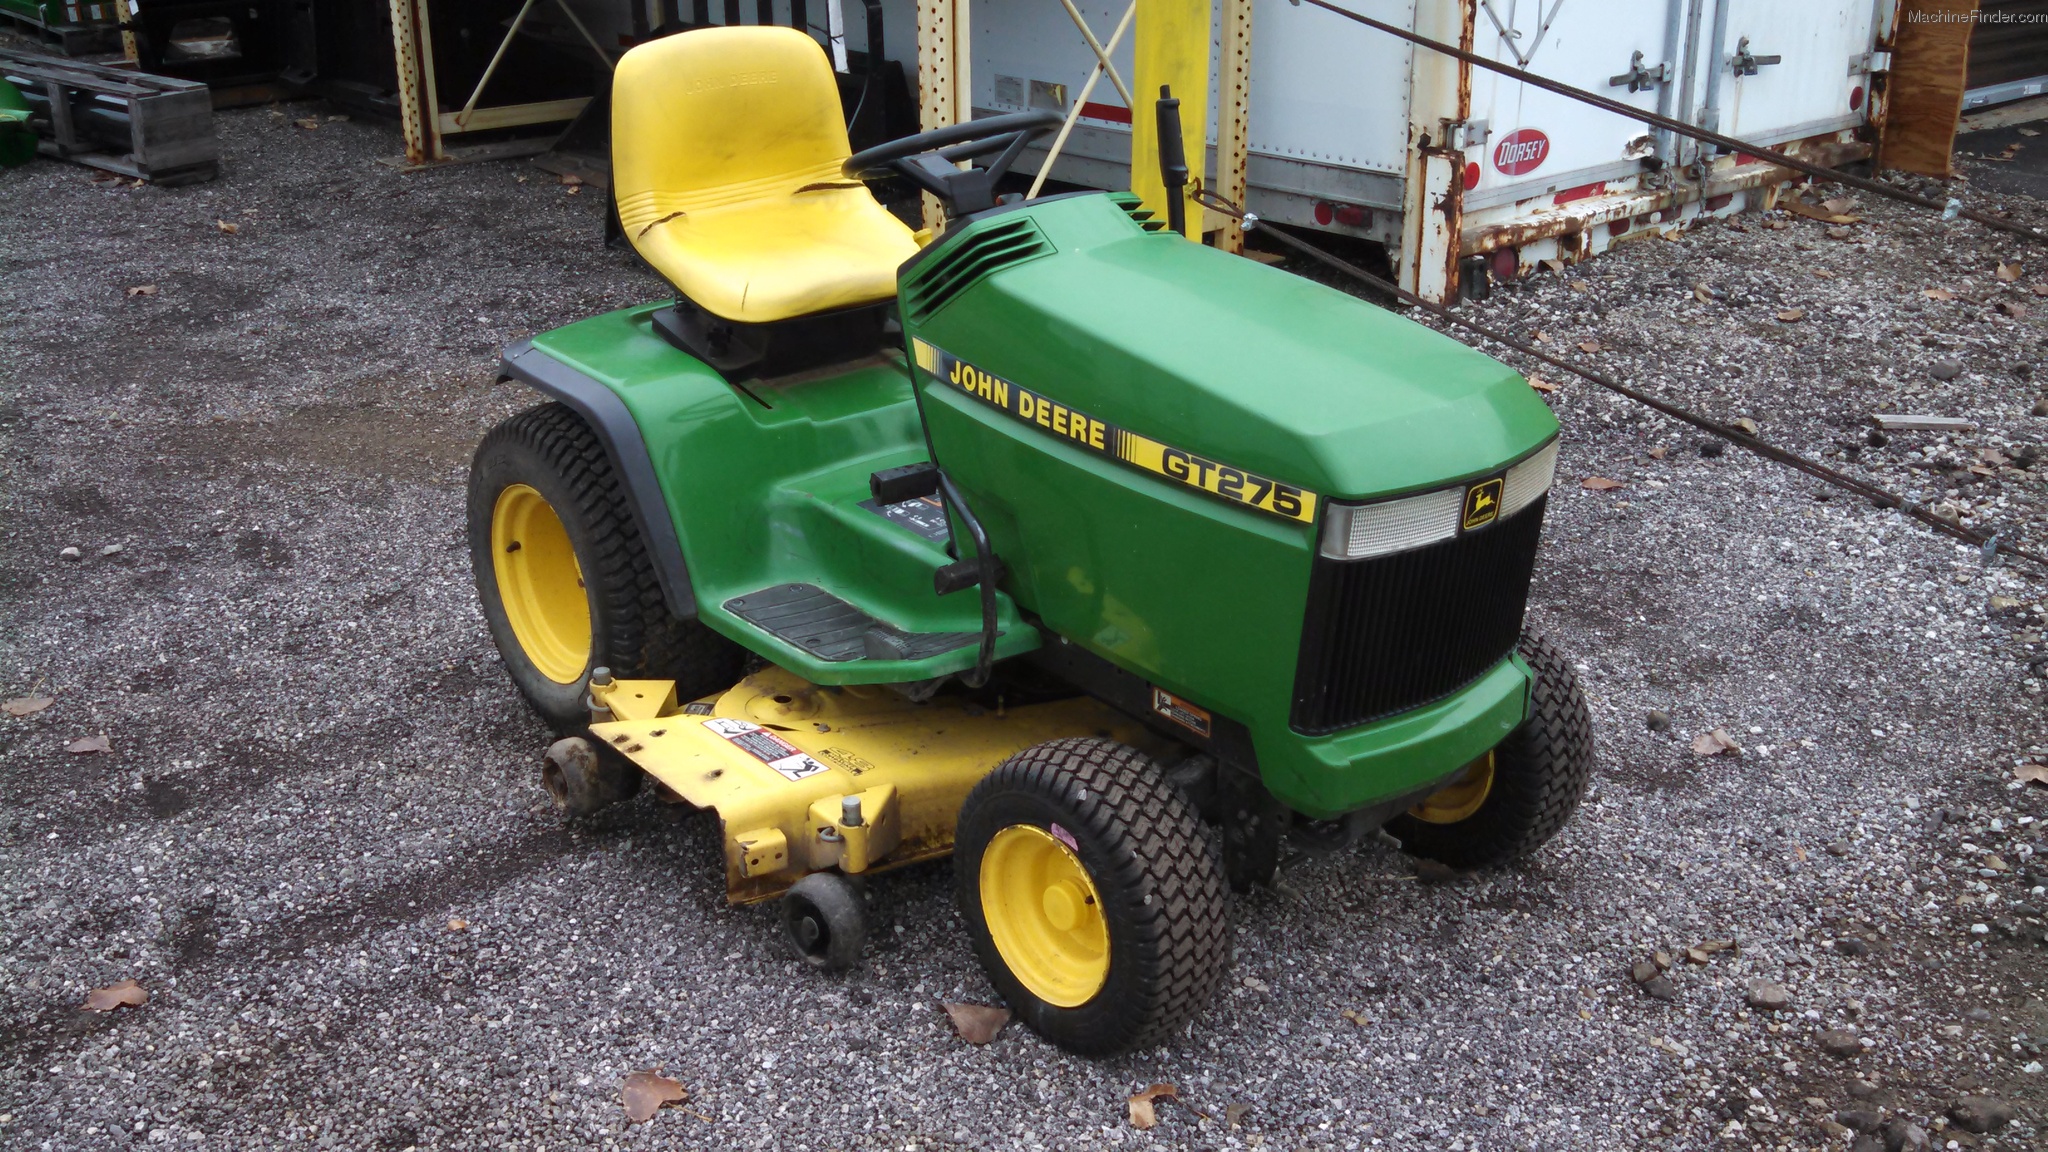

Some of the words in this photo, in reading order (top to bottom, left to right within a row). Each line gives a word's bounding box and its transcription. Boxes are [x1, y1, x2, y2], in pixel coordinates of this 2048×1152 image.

[729, 69, 778, 88] DEERE
[1498, 139, 1547, 167] DORSEY
[949, 360, 1009, 409] JOHN
[1018, 388, 1106, 451] DEERE
[1161, 447, 1302, 518] GT275
